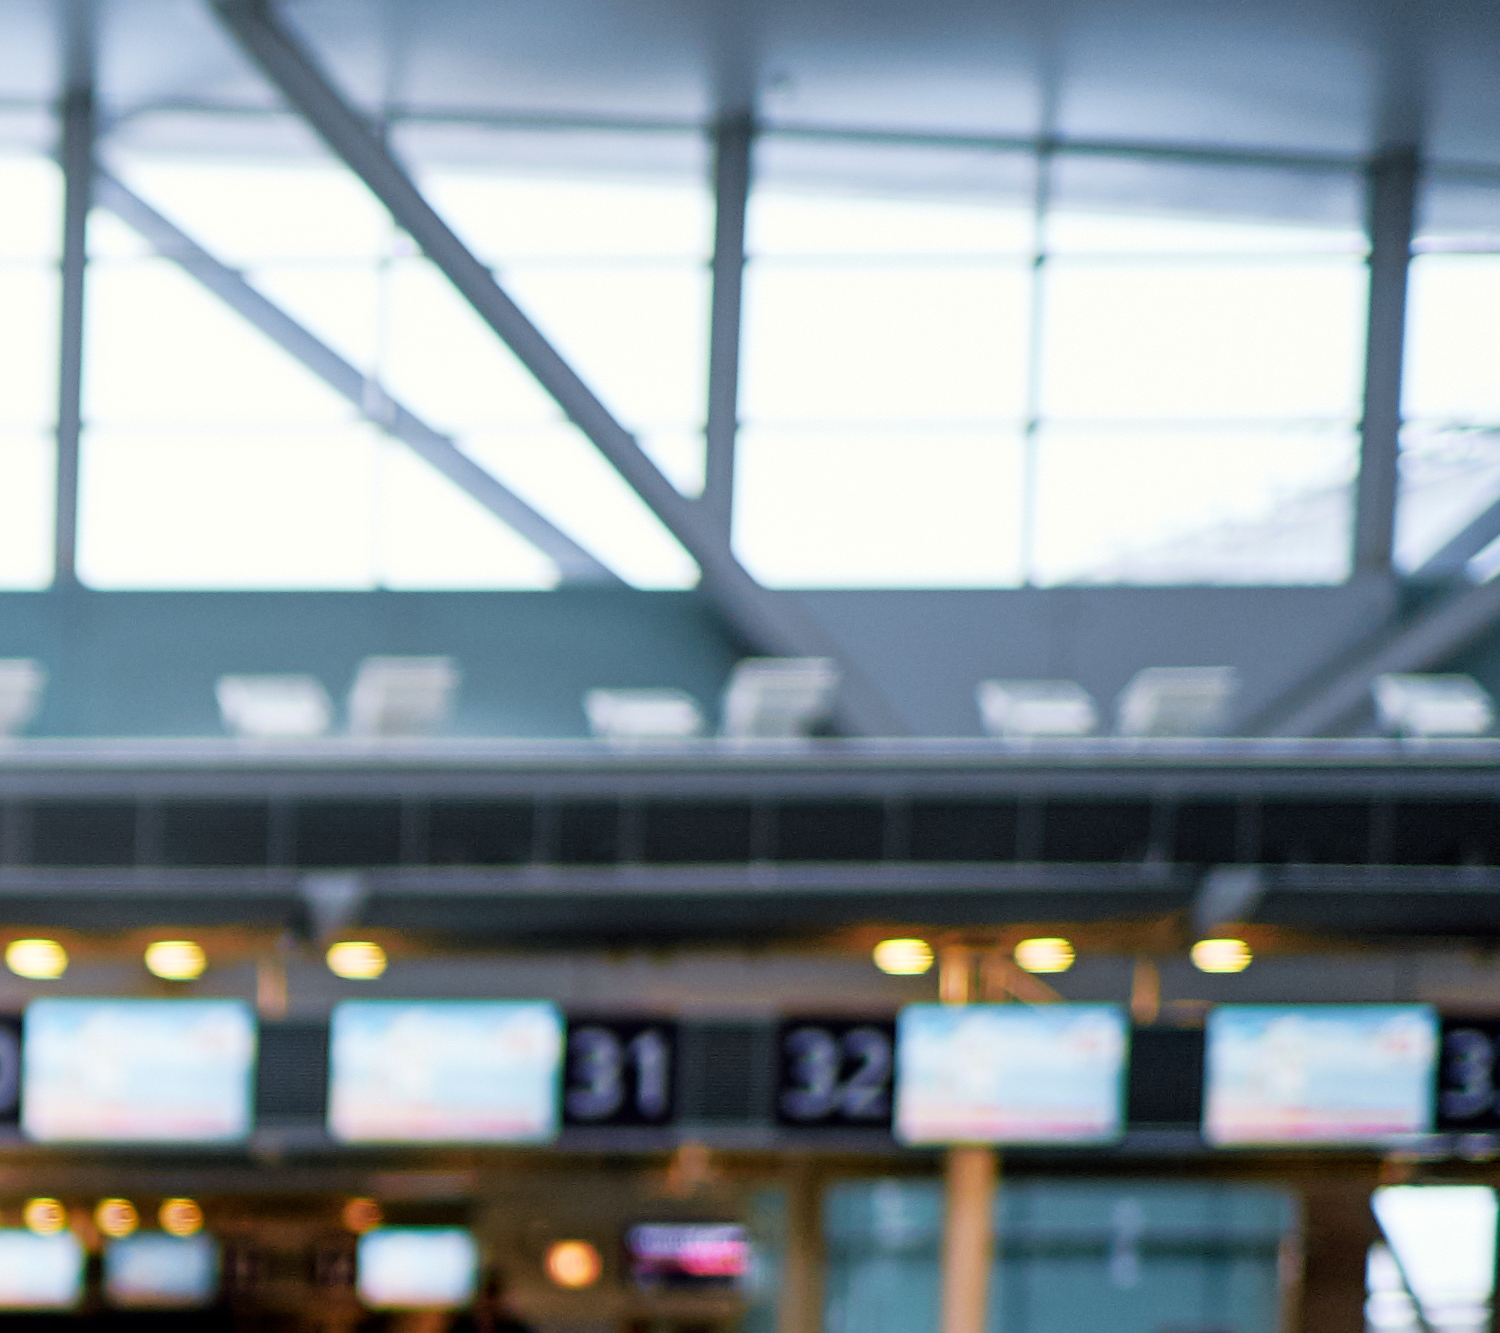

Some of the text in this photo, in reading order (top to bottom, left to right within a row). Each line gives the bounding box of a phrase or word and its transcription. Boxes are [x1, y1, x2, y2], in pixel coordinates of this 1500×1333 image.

[564, 1026, 669, 1120] 31
[783, 1026, 894, 1120] 32
[1441, 1028, 1500, 1121] 3
